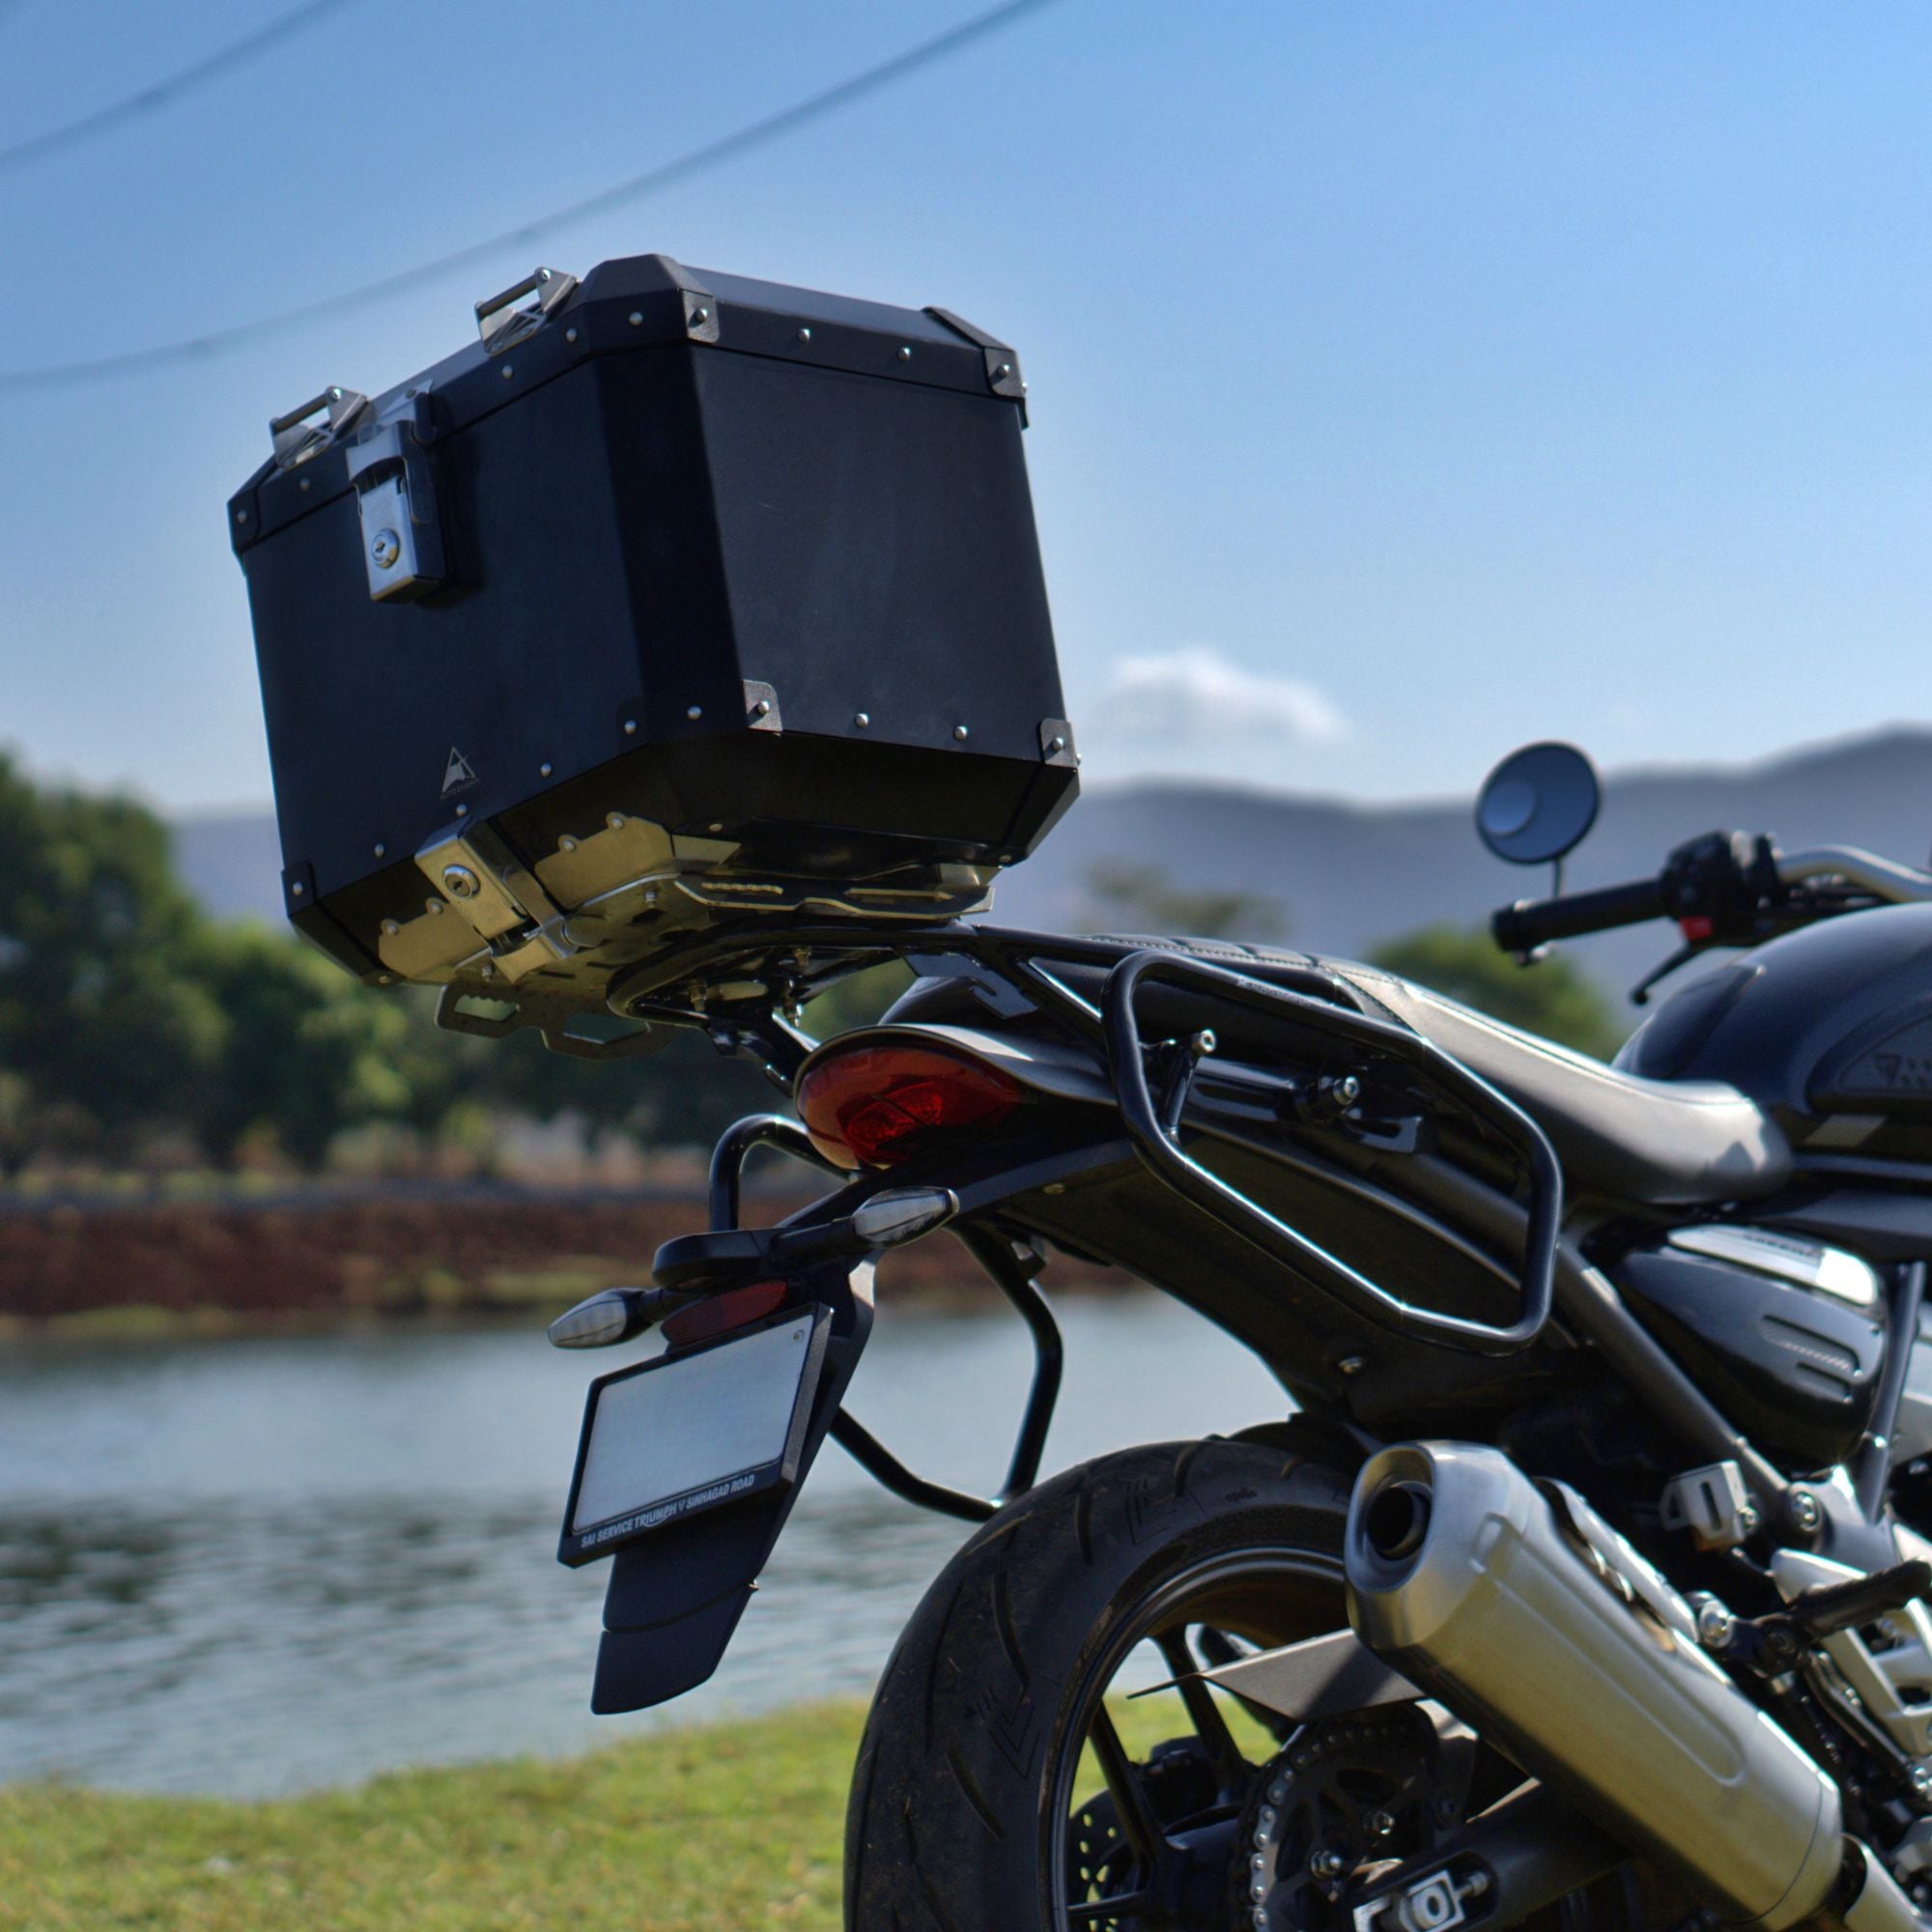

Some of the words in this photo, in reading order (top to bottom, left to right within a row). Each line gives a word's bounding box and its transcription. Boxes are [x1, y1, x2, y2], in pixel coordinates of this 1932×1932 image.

[581, 1532, 595, 1548] SAI
[597, 1518, 633, 1542] SERVICE
[635, 1502, 677, 1527] TRIUMPH
[686, 1484, 729, 1509] SINHAGAD
[731, 1475, 754, 1493] ROAD
